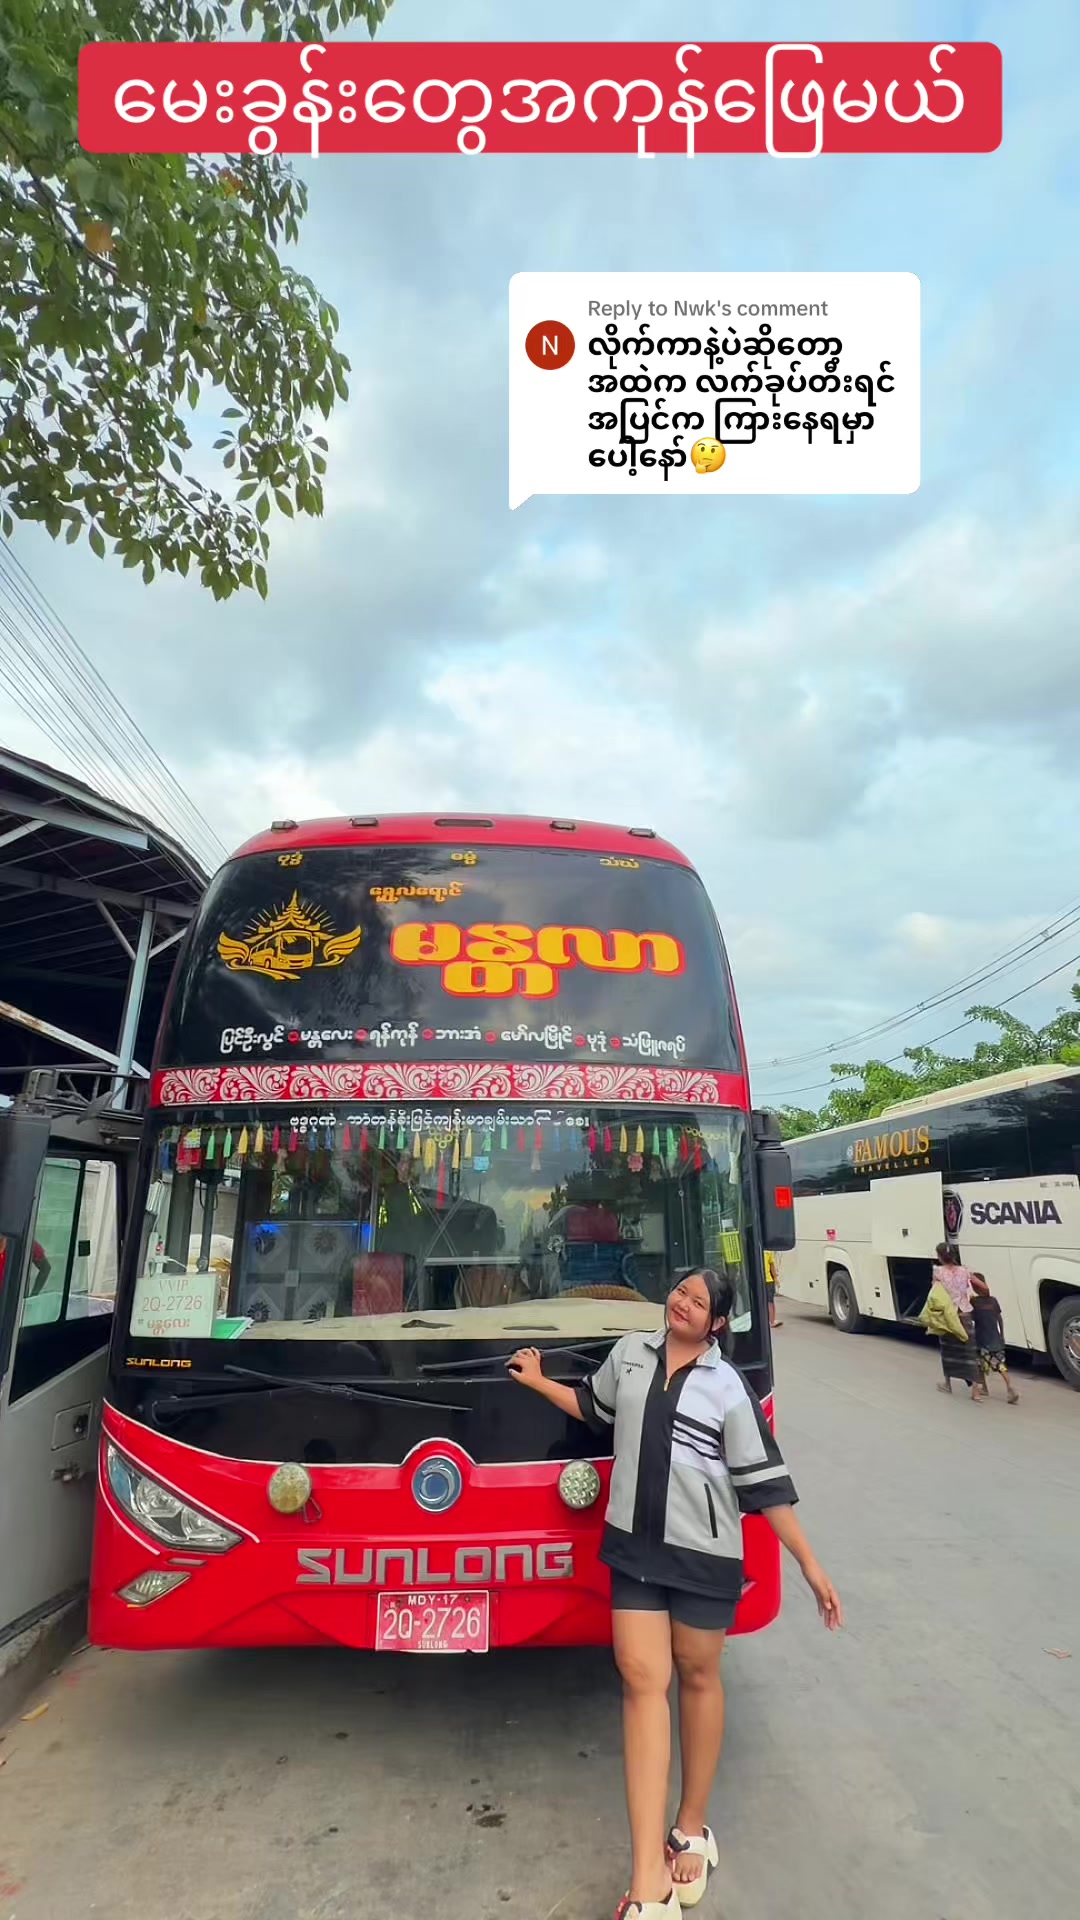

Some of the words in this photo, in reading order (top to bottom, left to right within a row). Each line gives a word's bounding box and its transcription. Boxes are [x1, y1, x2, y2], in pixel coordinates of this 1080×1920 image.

[369, 1021, 419, 1048] ရန်ကုန်
[854, 1125, 930, 1163] FAMOUS
[970, 1199, 1062, 1225] SCANIA
[143, 1295, 203, 1312] 2Q-2726
[126, 1357, 192, 1368] SUNLONG
[296, 1542, 574, 1585] SUNLONG
[408, 1594, 459, 1606] MDY-17
[383, 1606, 481, 1640] 2Q-2726
